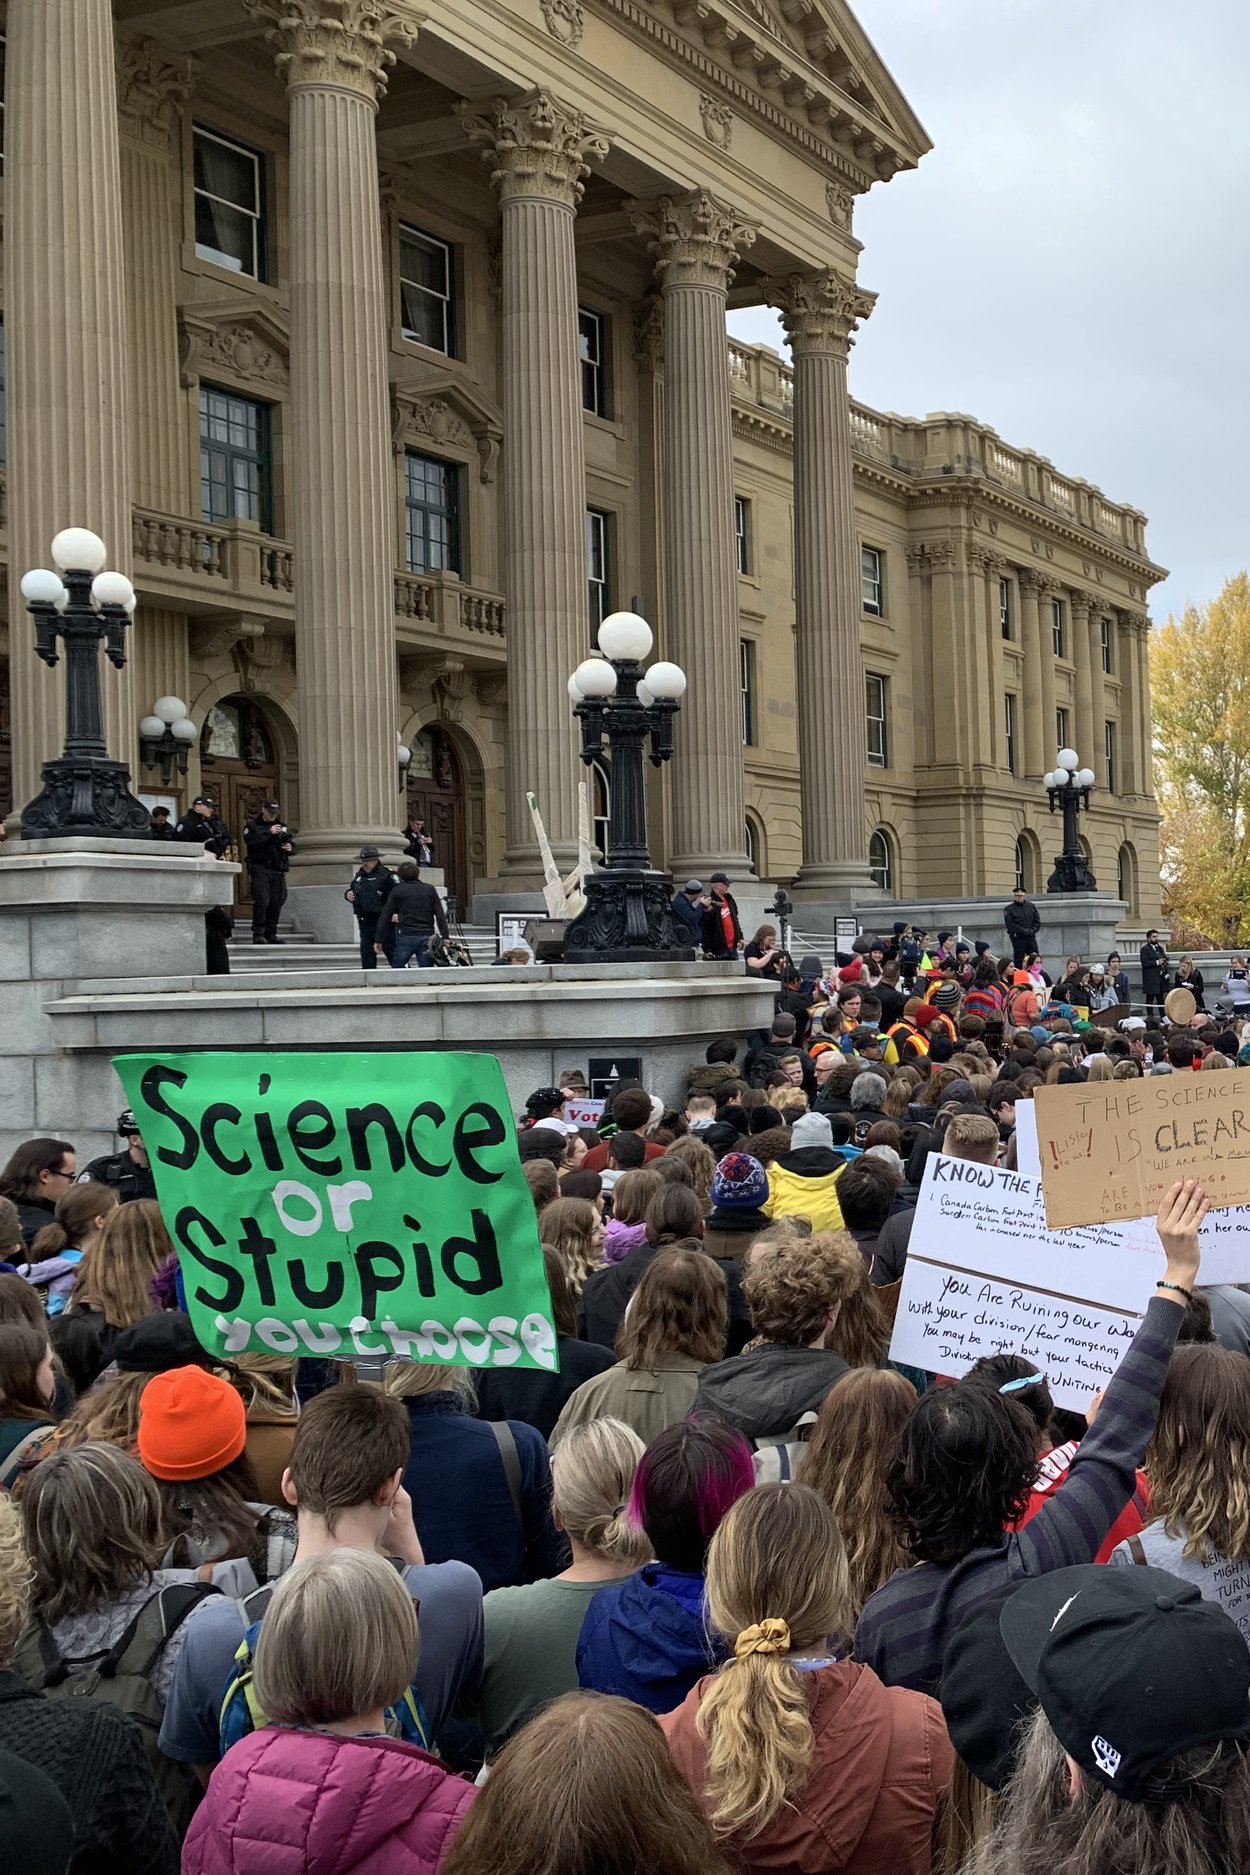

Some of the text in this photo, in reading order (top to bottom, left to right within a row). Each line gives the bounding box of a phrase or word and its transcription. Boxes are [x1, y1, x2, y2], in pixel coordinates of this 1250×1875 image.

[1075, 1081, 1248, 1124] THE SCIENCE
[141, 1064, 507, 1185] Science
[568, 1109, 600, 1123] Vot
[1114, 1129, 1143, 1163] IS
[1176, 1156, 1197, 1167] ARE
[933, 1158, 994, 1188] KNOW
[998, 1173, 1031, 1194] THE
[941, 1194, 971, 1210] Canada
[1101, 1185, 1129, 1206] ARE
[273, 1179, 373, 1237] or
[940, 1208, 971, 1219] Sweden
[1216, 1222, 1232, 1233] her
[1038, 1234, 1050, 1244] the
[1068, 1242, 1087, 1250] year
[175, 1206, 503, 1321] Stupid
[933, 1306, 968, 1324] your
[977, 1283, 1004, 1306] Are
[1009, 1290, 1069, 1329] Ruining
[1073, 1314, 1102, 1330] our
[215, 1312, 558, 1371] you choose
[942, 1329, 965, 1345] may
[968, 1332, 982, 1344] be
[991, 1337, 1014, 1352] right
[1020, 1344, 1040, 1356] but
[1045, 1350, 1071, 1364] your
[1075, 1355, 1114, 1375] tactics
[1213, 1562, 1244, 1581] MIGHT
[1215, 1577, 1250, 1599] TURN
[1228, 1595, 1243, 1609] FOR
